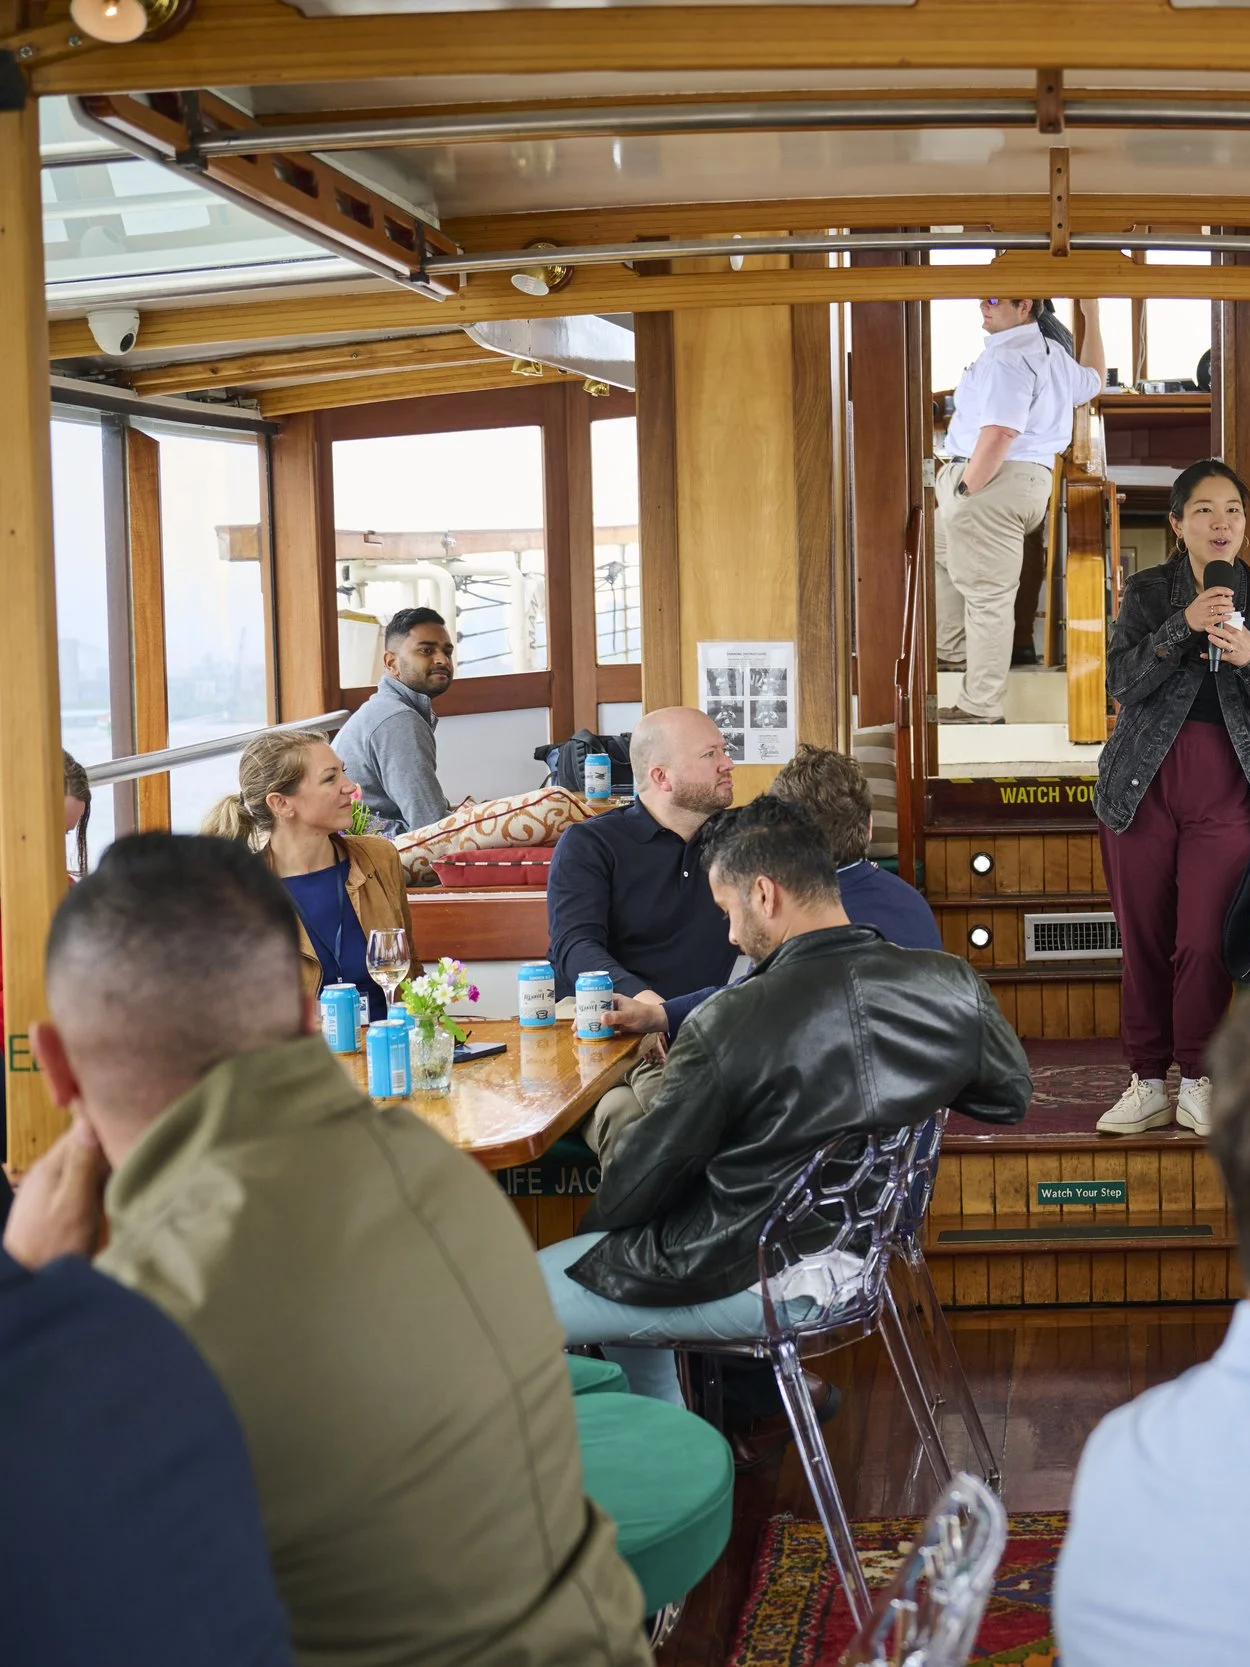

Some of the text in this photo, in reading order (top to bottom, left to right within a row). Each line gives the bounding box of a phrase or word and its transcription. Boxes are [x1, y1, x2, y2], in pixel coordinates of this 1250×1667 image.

[1000, 787, 1060, 803] WATCH
[506, 1166, 601, 1194] IFE JAC
[1041, 1187, 1122, 1198] Watch Your Step
